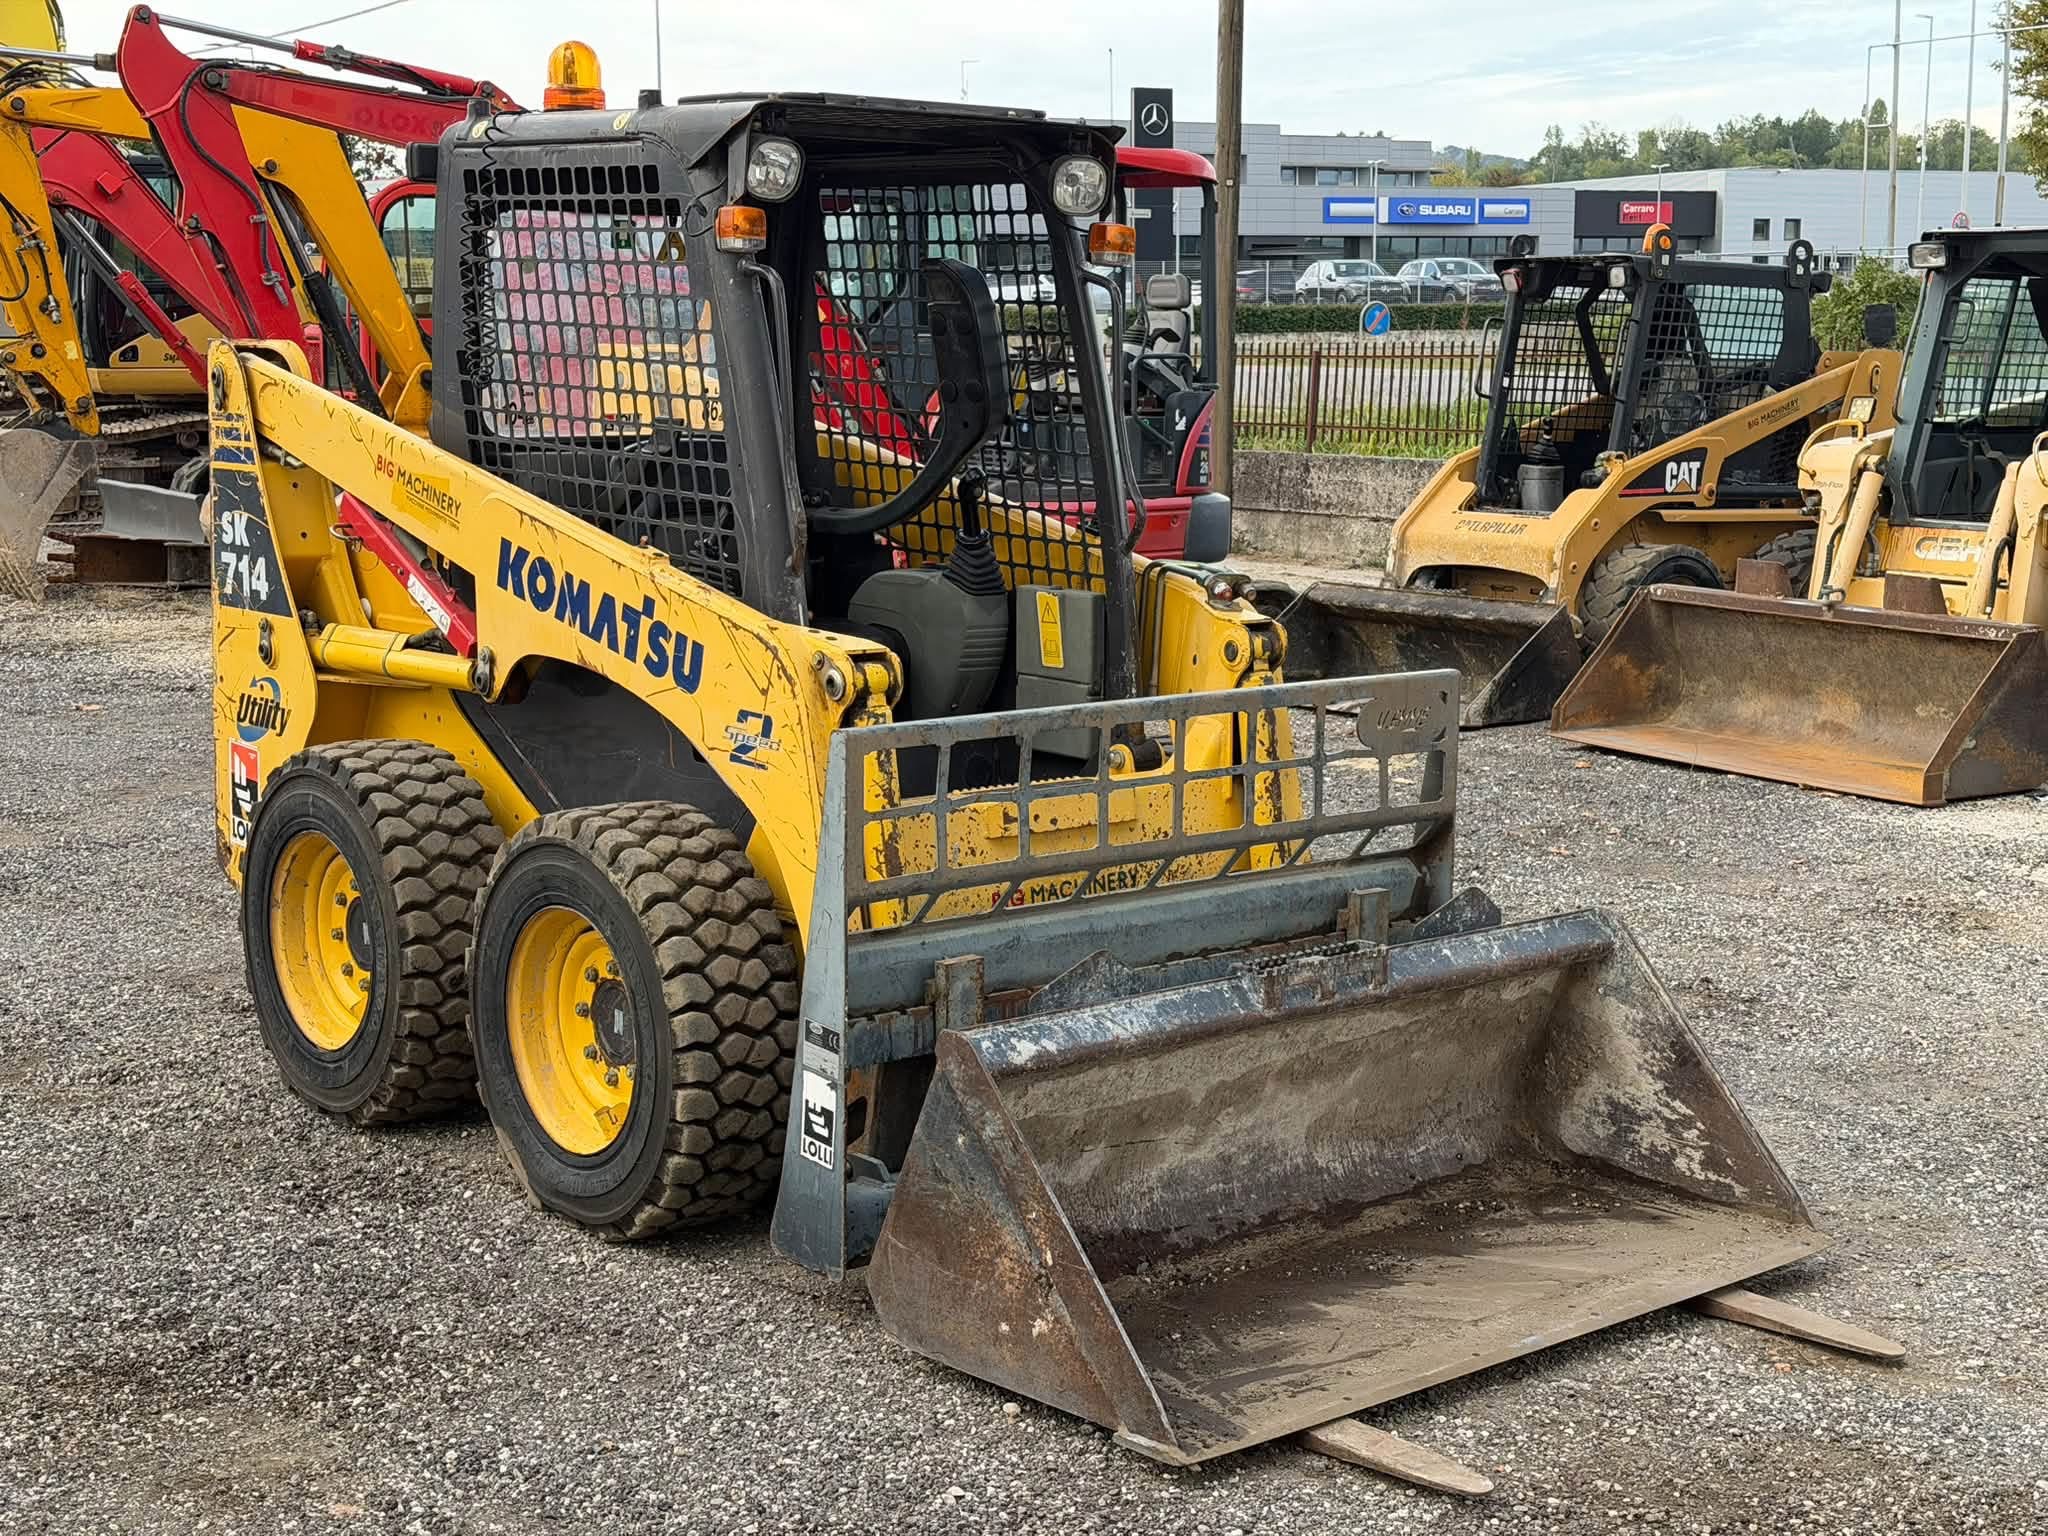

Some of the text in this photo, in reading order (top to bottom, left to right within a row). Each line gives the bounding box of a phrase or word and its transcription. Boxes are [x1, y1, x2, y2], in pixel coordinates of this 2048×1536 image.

[1419, 205, 1471, 216] SUBARU
[1623, 203, 1655, 213] Carraro
[376, 454, 395, 479] BIG
[396, 465, 462, 518] MACHINERY
[1665, 461, 1701, 493] CAT
[221, 510, 250, 548] SK
[1454, 519, 1528, 536] CATERPILLAR
[220, 551, 269, 601] 714
[497, 536, 705, 695] KOMATSU
[237, 693, 292, 737] Utility
[991, 870, 1138, 908] BG MACINERY
[802, 1137, 833, 1166] LOLLI
